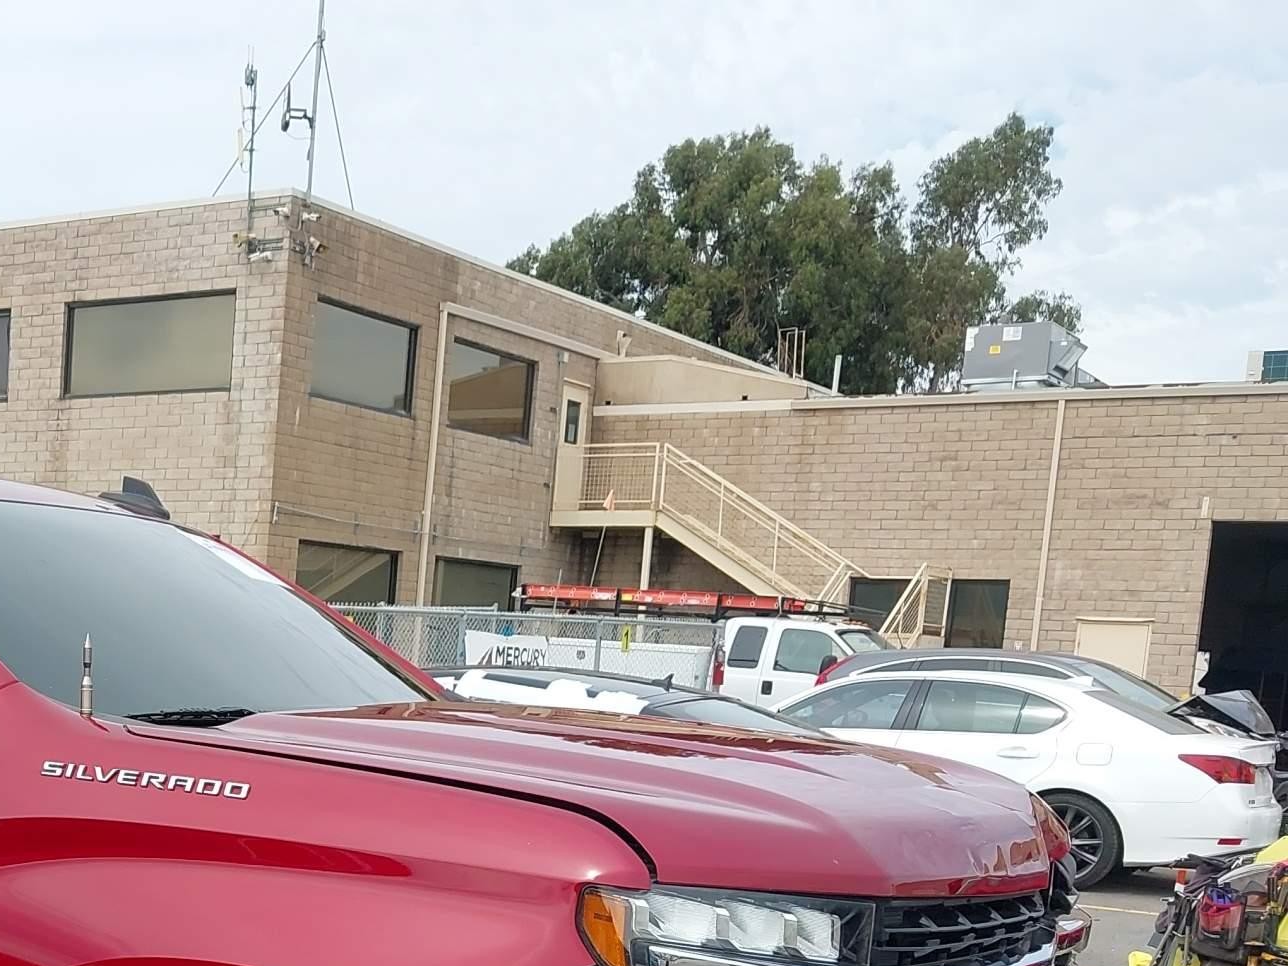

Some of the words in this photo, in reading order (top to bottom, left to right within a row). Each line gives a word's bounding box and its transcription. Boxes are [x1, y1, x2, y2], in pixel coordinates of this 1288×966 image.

[623, 629, 630, 650] 1
[495, 646, 547, 667] MERCURY
[41, 760, 251, 800] SILVERADO
